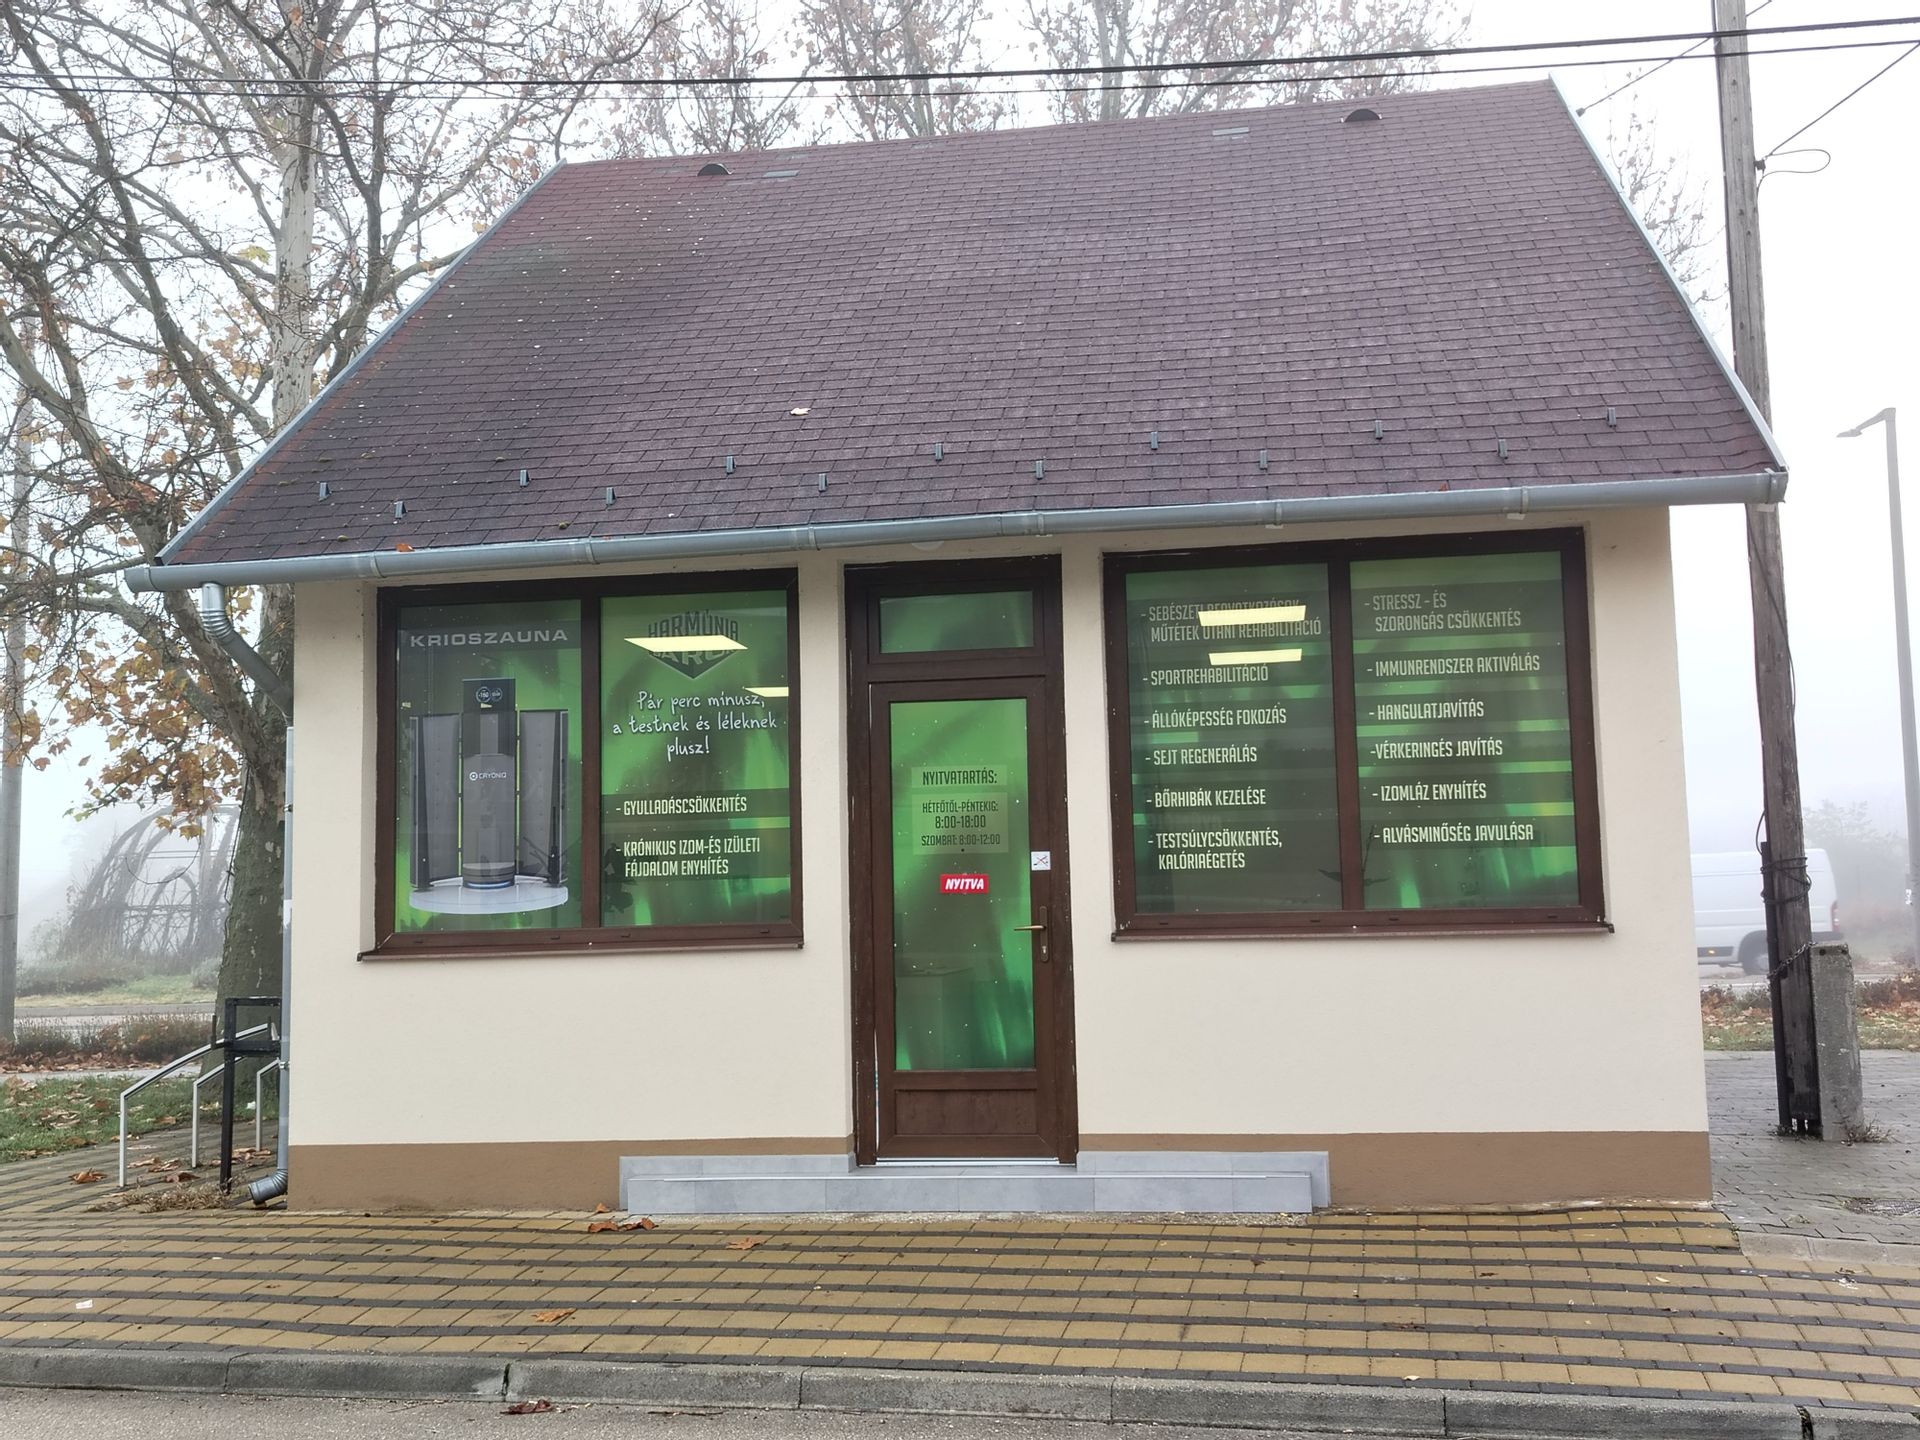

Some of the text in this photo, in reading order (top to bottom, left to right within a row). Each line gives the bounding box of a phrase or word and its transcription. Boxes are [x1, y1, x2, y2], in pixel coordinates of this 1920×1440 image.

[1372, 593, 1422, 611] STRESSZ
[1433, 589, 1447, 608] ÉS
[1375, 607, 1521, 632] SZORONGÁS CSÖKKENTÉS
[410, 629, 568, 648] KRIOSZAUNA
[1151, 623, 1199, 642] MŰTÉTEK
[1151, 664, 1269, 686] SPORTREHABILITÁCIÓ
[1375, 657, 1473, 677] IMMUNRENDSZER
[1477, 652, 1540, 673] AKTIVÁLÁS
[636, 691, 765, 714] Pár perc mínusz,
[1377, 698, 1484, 720] HANGULATJAVÍTÁS
[612, 711, 777, 735] a testnek és léleknek
[1152, 707, 1233, 729] ÁLLÓKÉPESSÉG
[1236, 705, 1287, 725] FOKOZÁS
[667, 735, 710, 762] plusz!
[1153, 749, 1178, 766] SEJT
[1181, 744, 1258, 765] REGENERÁLÁS
[1456, 736, 1503, 757] JAVÍTÁS
[922, 767, 998, 785] NYITVATARTÁS:
[1155, 788, 1213, 808] BŐRHIBÁK
[1215, 786, 1266, 806] KEZELÉSE
[1380, 781, 1430, 802] IZOMLÁZ
[1433, 780, 1487, 801] ENYHÍTÉS
[623, 794, 748, 816] GYULLADÁSCSÖKKENTÉS
[922, 800, 998, 813] HÉTFŐTŐL-PÉNTEKIG:
[935, 815, 986, 829] 8:00-18:00
[1383, 822, 1471, 844] ALVÁSMINŐSÉG
[1474, 821, 1534, 842] JAVULÁSA
[623, 837, 677, 857] KRÓNIKUS
[679, 837, 721, 855] IZOM-ÉS
[724, 836, 760, 853] IZÜLETI
[921, 833, 1001, 846] SZOMBAT: 8:00-12:00
[1156, 827, 1283, 849] TESTSÚLYCSÖKKENTÉS,
[625, 857, 729, 877] FÁJDALOM ENYHÍTÉS
[1158, 850, 1246, 870] KALÓRIAÉGETÉS
[945, 878, 984, 890] NYITVA
